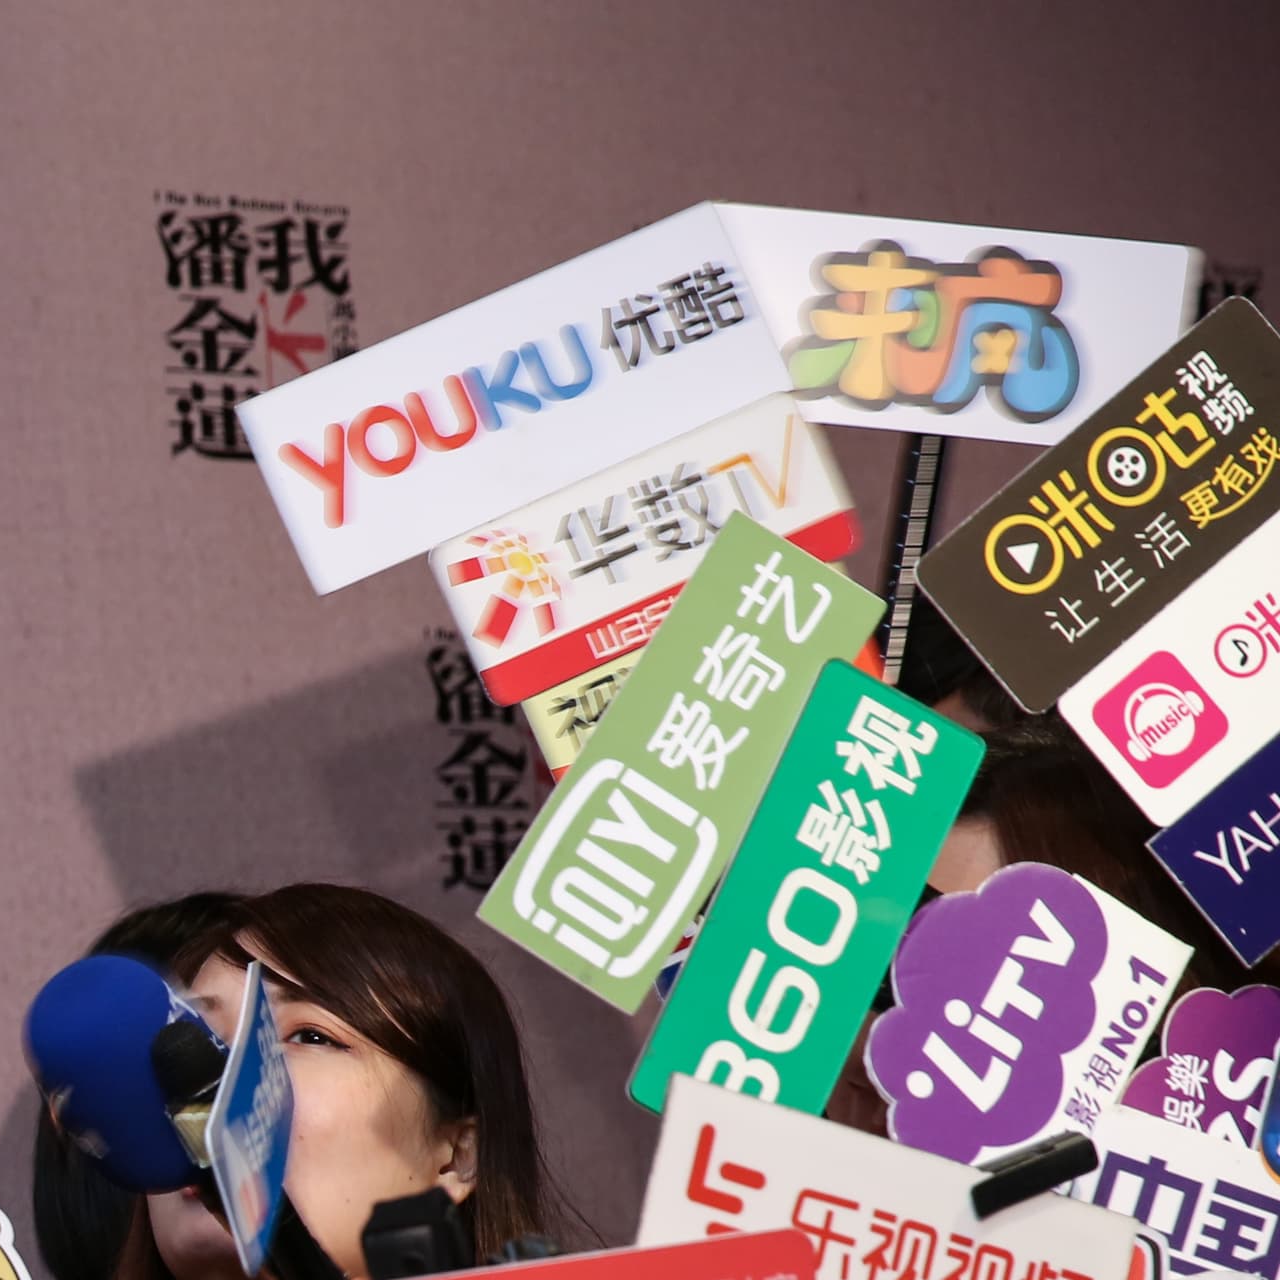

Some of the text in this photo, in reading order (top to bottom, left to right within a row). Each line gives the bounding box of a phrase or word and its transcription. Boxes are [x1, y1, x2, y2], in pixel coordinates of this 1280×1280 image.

[278, 261, 743, 530] YOUKU 优酷
[1175, 350, 1256, 437] 视频
[1043, 427, 1280, 645] 让生活更有戏
[646, 550, 832, 791] 爱奇艺
[1138, 701, 1192, 750] music
[920, 898, 1077, 1114] LiTV
